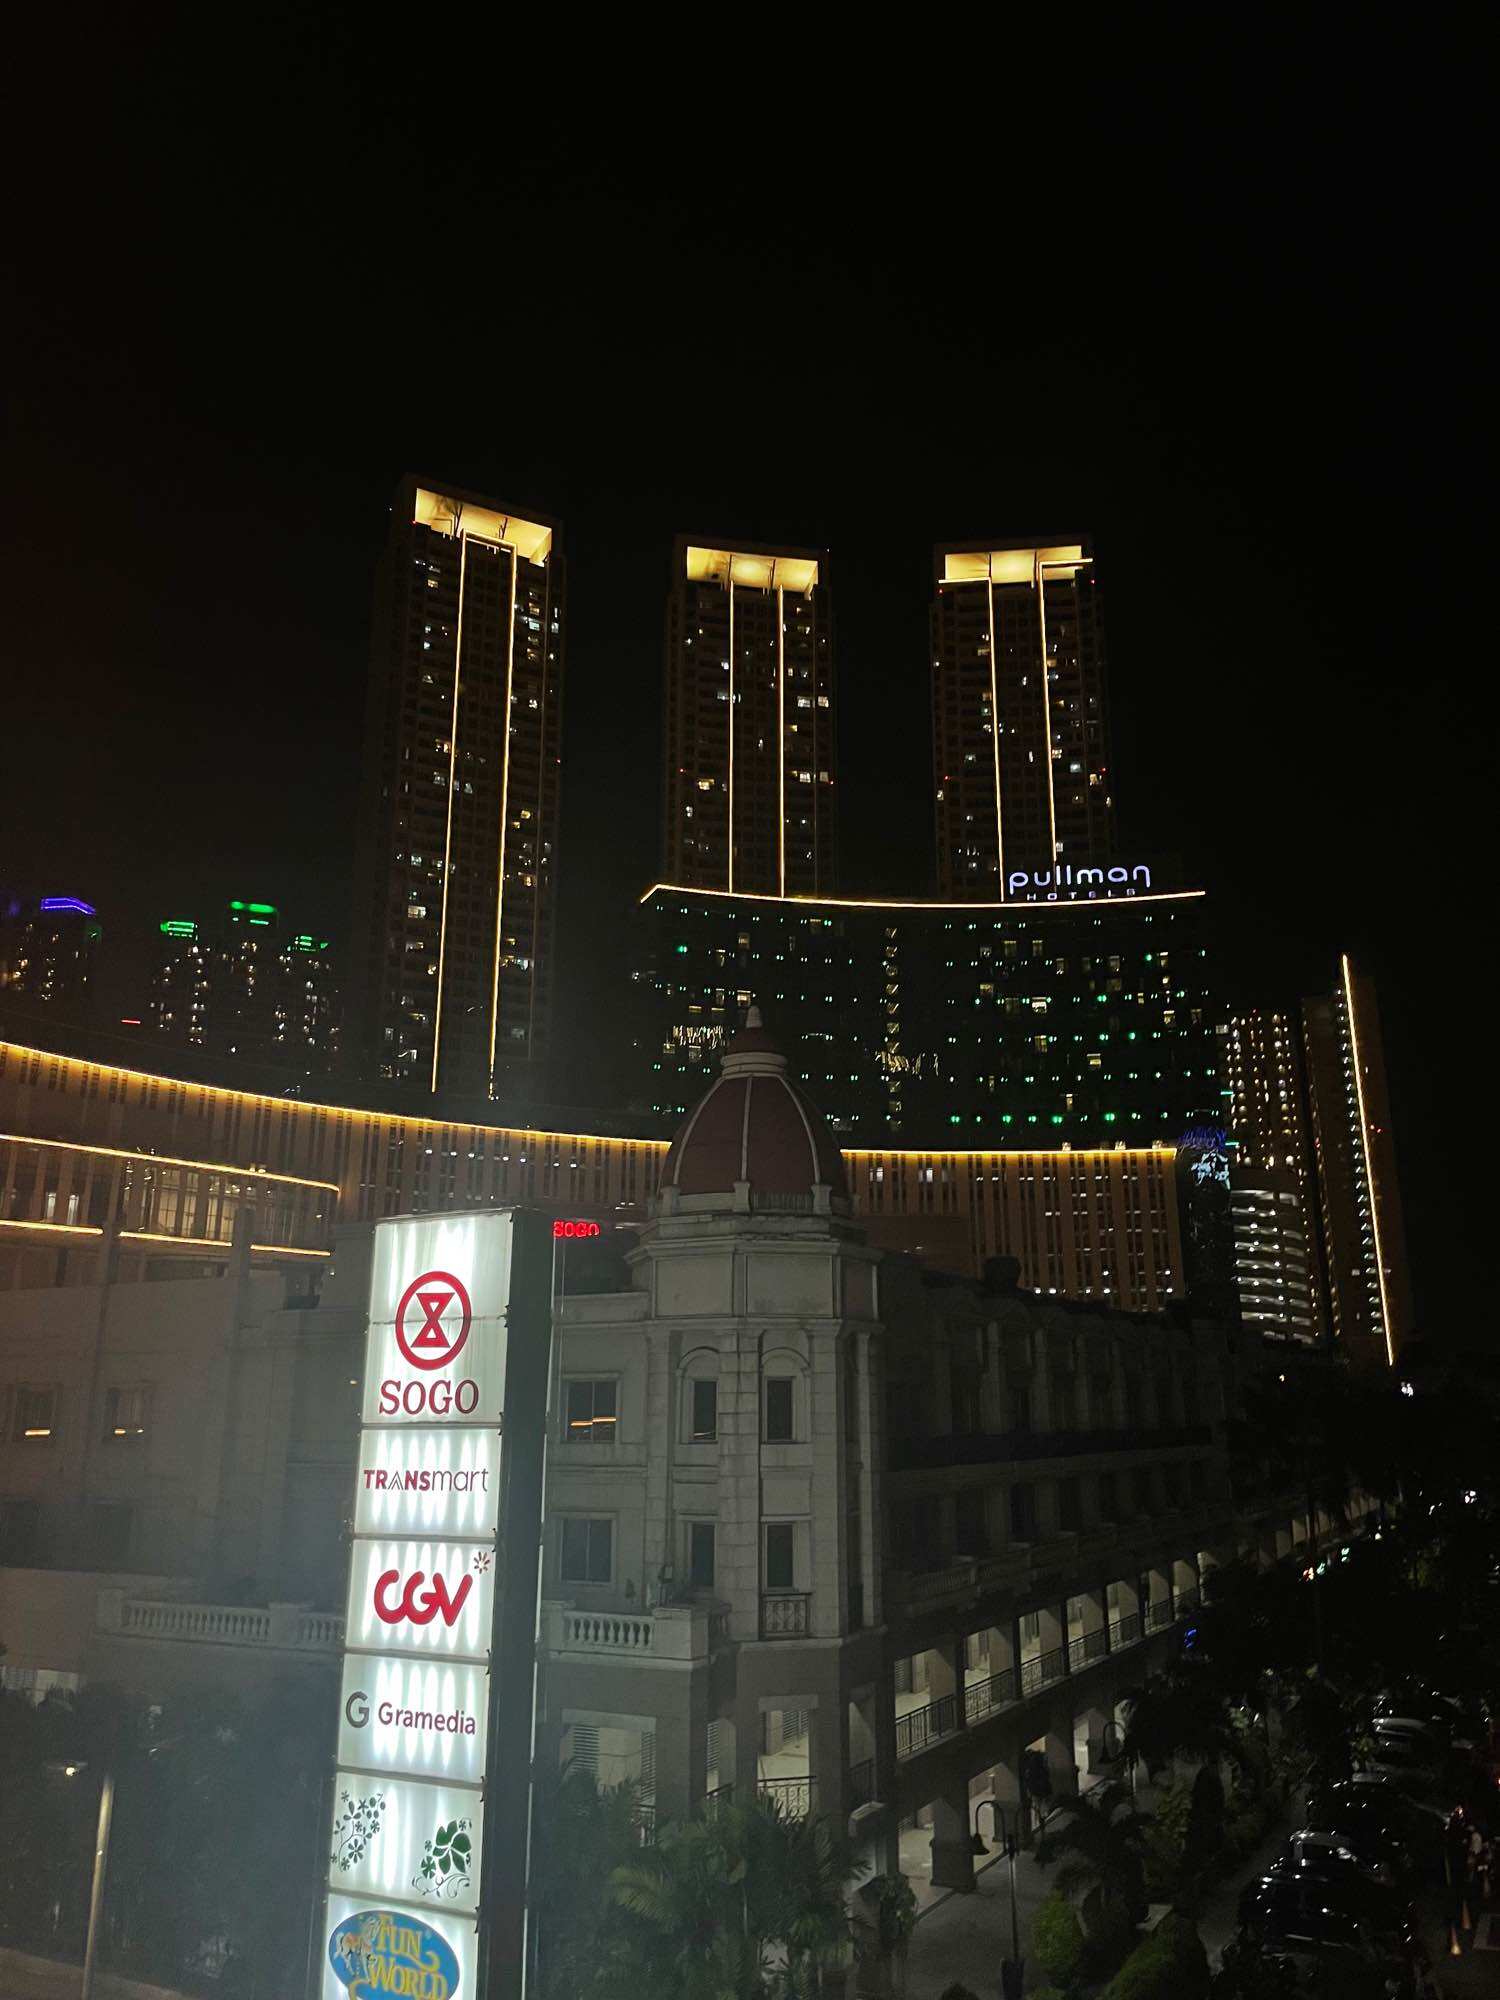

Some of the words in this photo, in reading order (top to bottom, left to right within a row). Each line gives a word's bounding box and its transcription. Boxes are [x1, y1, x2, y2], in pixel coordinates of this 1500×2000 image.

[1009, 864, 1151, 895] pullman
[379, 1379, 479, 1415] SOGO
[363, 1468, 489, 1492] TRANSmart
[374, 1569, 473, 1627] CGV
[345, 1691, 370, 1728] G
[378, 1702, 476, 1735] Gramedia
[375, 1914, 433, 1966] FUN
[369, 1955, 448, 2000] WORLD
